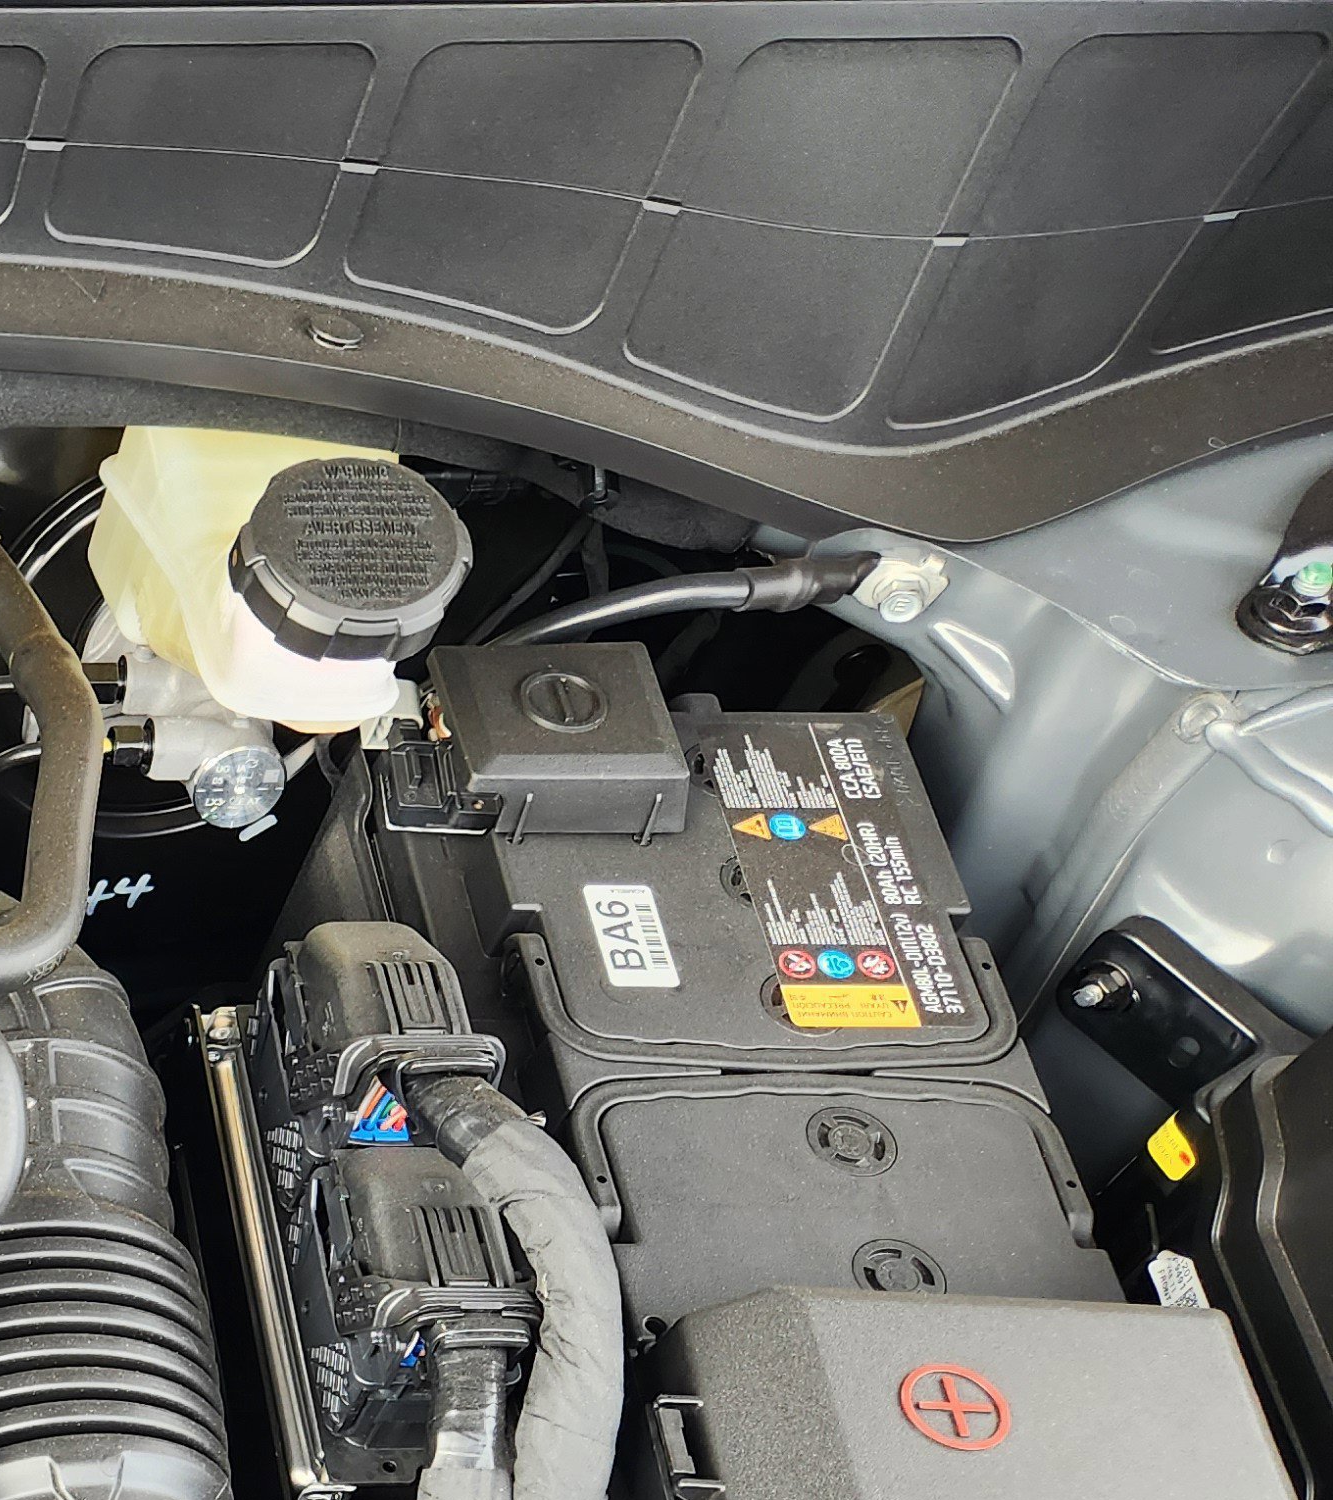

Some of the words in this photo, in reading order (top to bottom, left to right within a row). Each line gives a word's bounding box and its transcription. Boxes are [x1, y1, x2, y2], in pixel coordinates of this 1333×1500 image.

[321, 464, 390, 480] WARNING
[304, 519, 420, 537] AVERTISSEMENT
[827, 738, 854, 771] 800A
[843, 773, 864, 800] CCA
[856, 821, 885, 868] (20HR)
[884, 836, 915, 883] 155min
[874, 869, 900, 905] 80Ah
[898, 884, 923, 905] RC
[595, 898, 649, 972] BA6
[923, 923, 966, 1015] 37110-D3802
